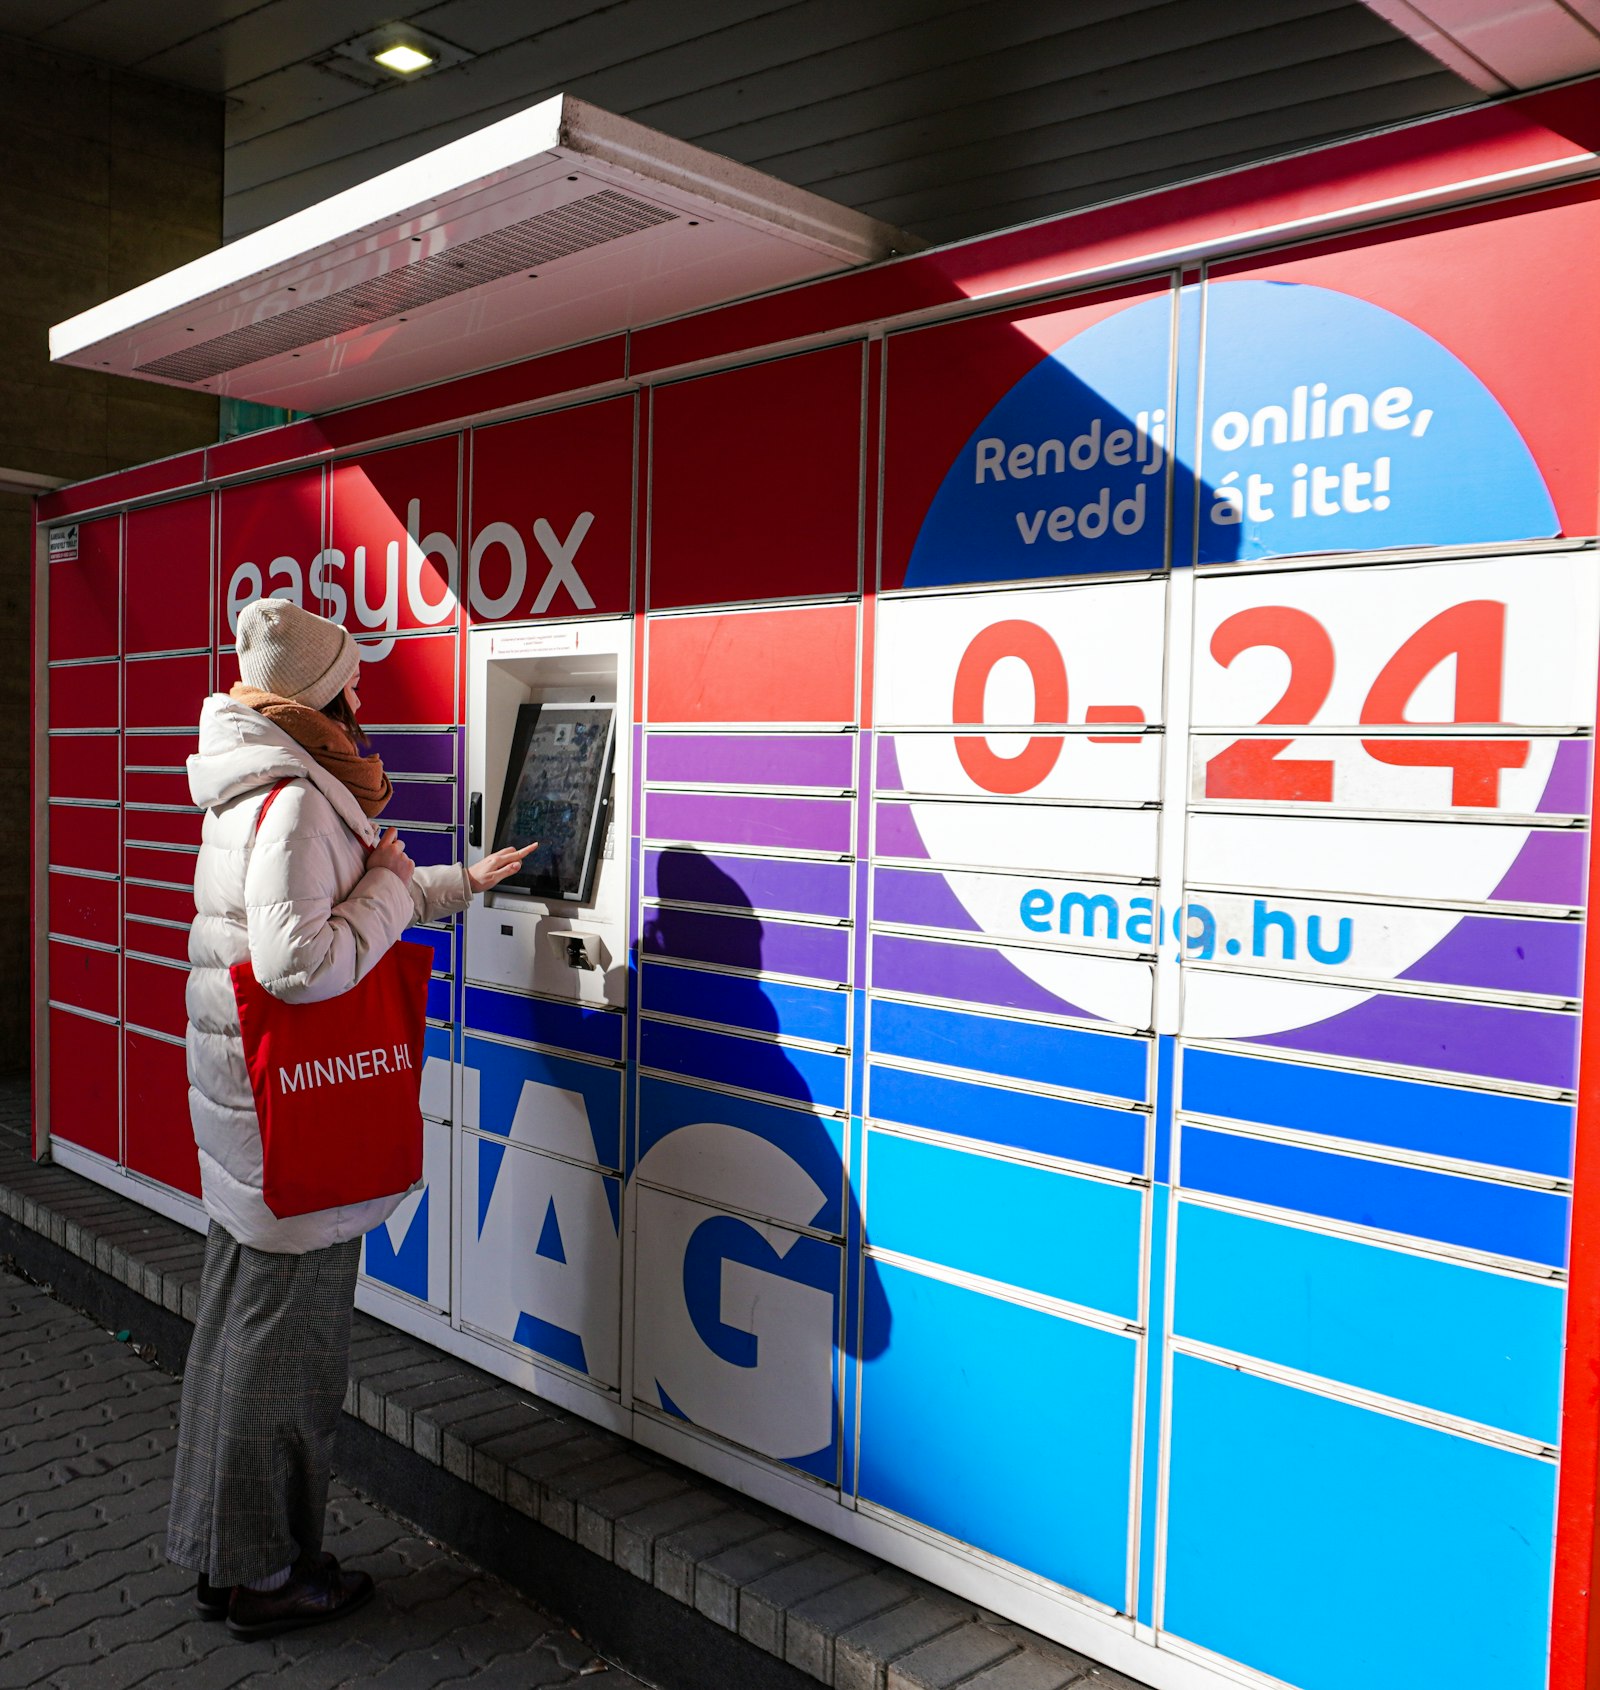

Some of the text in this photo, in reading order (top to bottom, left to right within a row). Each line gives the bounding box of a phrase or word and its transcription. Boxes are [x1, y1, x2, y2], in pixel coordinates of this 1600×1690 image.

[974, 382, 1434, 485] Rendelj online,
[1016, 457, 1391, 544] vedd át itt!
[227, 498, 596, 662] easybox
[1020, 888, 1353, 965] emag.hu
